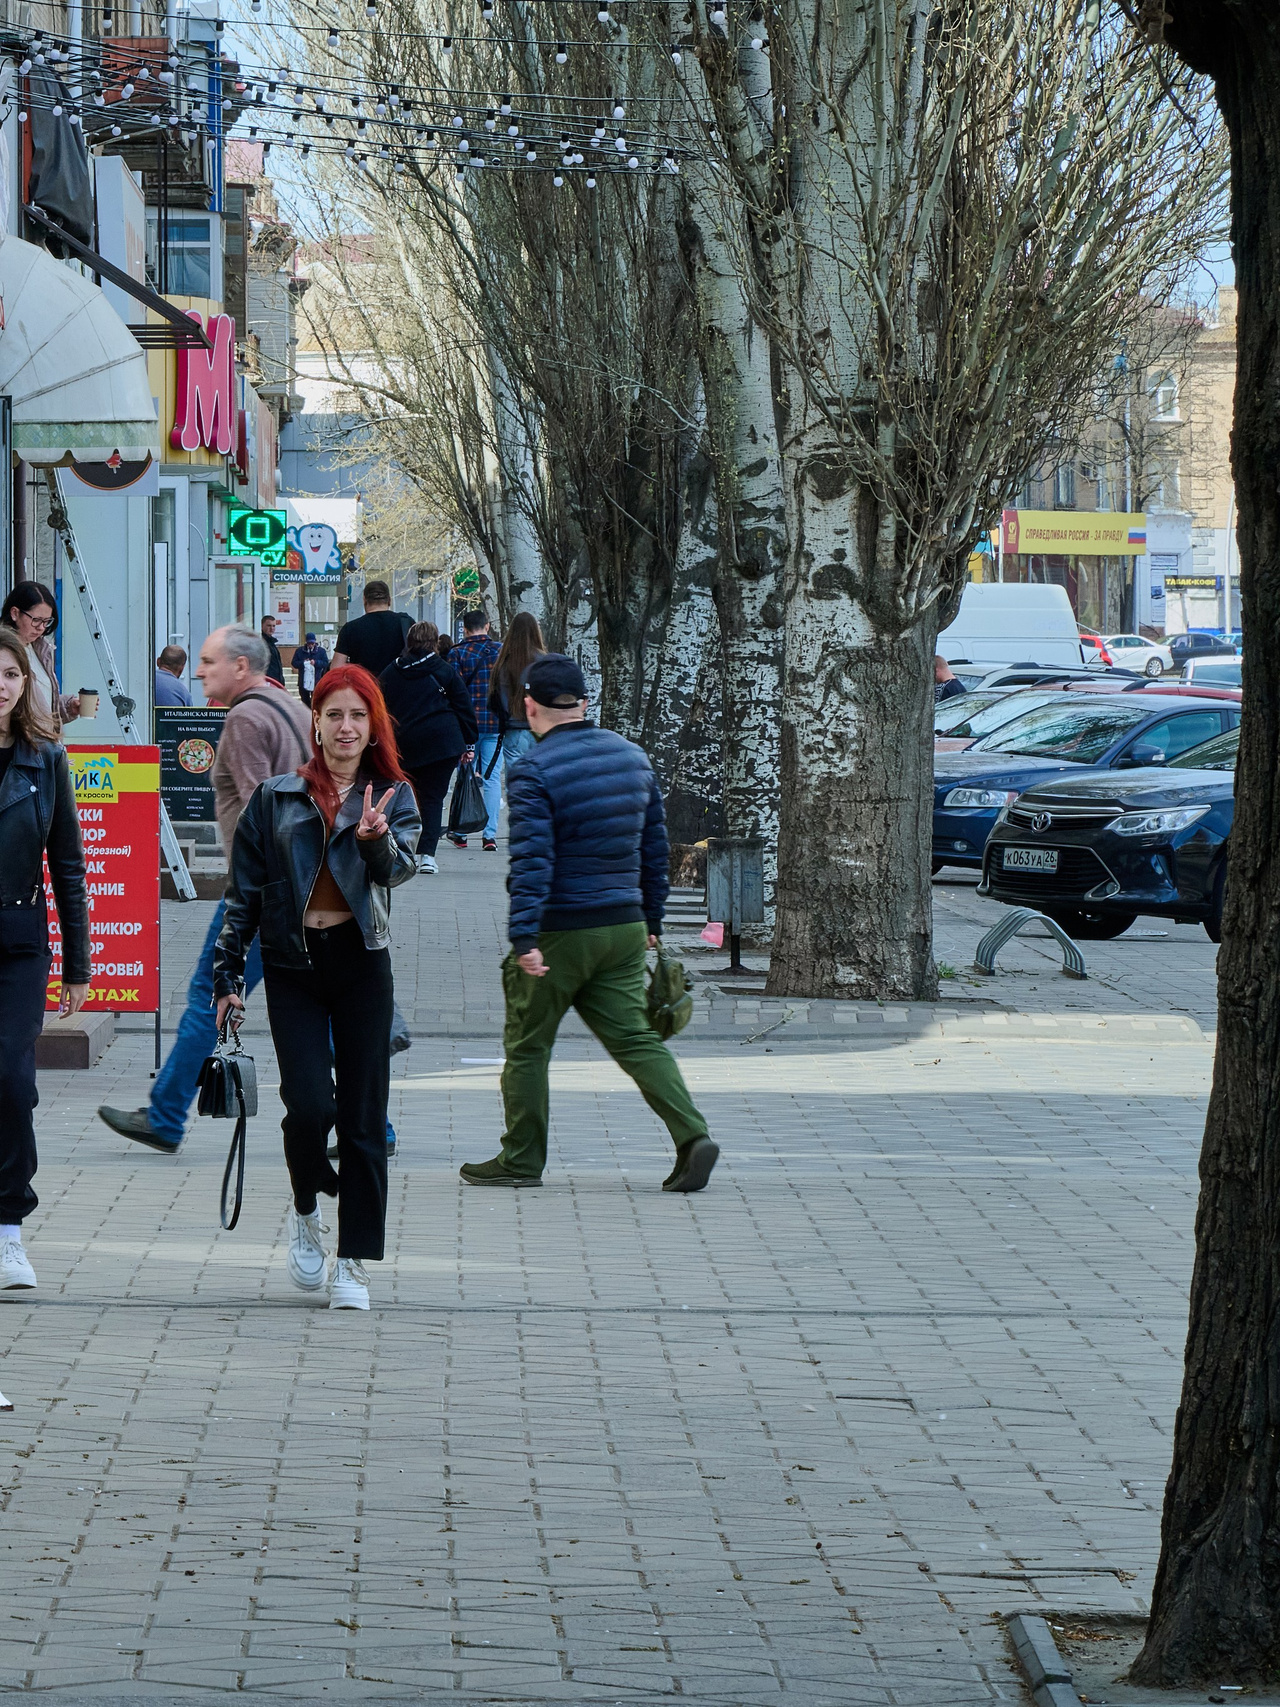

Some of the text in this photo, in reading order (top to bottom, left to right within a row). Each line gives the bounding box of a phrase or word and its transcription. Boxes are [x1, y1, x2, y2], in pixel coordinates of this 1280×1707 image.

[1025, 529, 1067, 541] СПРАВЕДЛИВАЯ
[1068, 530, 1090, 540] РОССИЯ
[1094, 530, 1101, 540] ЗА
[1102, 530, 1124, 542] ПРАВДУ
[273, 573, 341, 582] СТОМАТОЛОГИЯ
[70, 768, 114, 790] ЙКА
